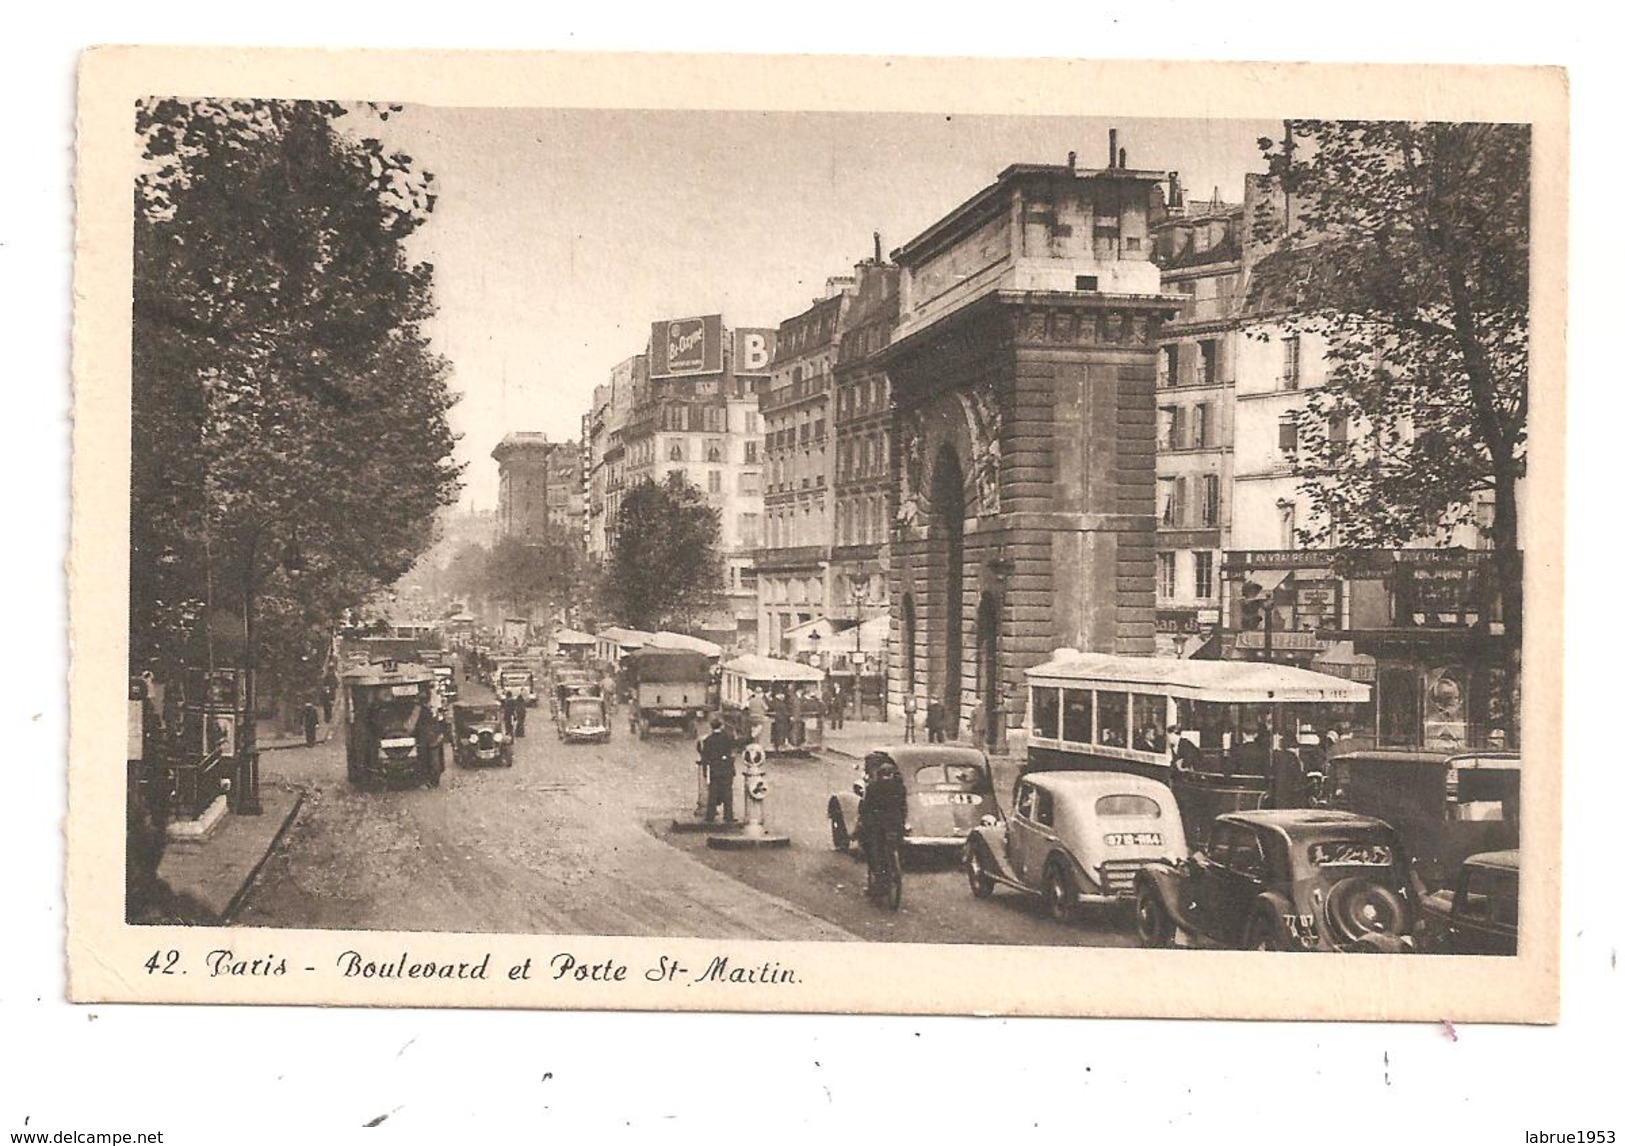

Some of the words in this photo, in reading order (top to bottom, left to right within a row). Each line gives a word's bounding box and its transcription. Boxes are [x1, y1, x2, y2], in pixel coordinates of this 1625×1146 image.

[744, 333, 769, 369] B
[144, 950, 187, 975] 42.
[206, 949, 286, 977] Paris
[336, 950, 491, 980] Boulevard
[508, 957, 531, 980] et
[550, 953, 627, 981] Porte
[694, 956, 803, 984] Martin.
